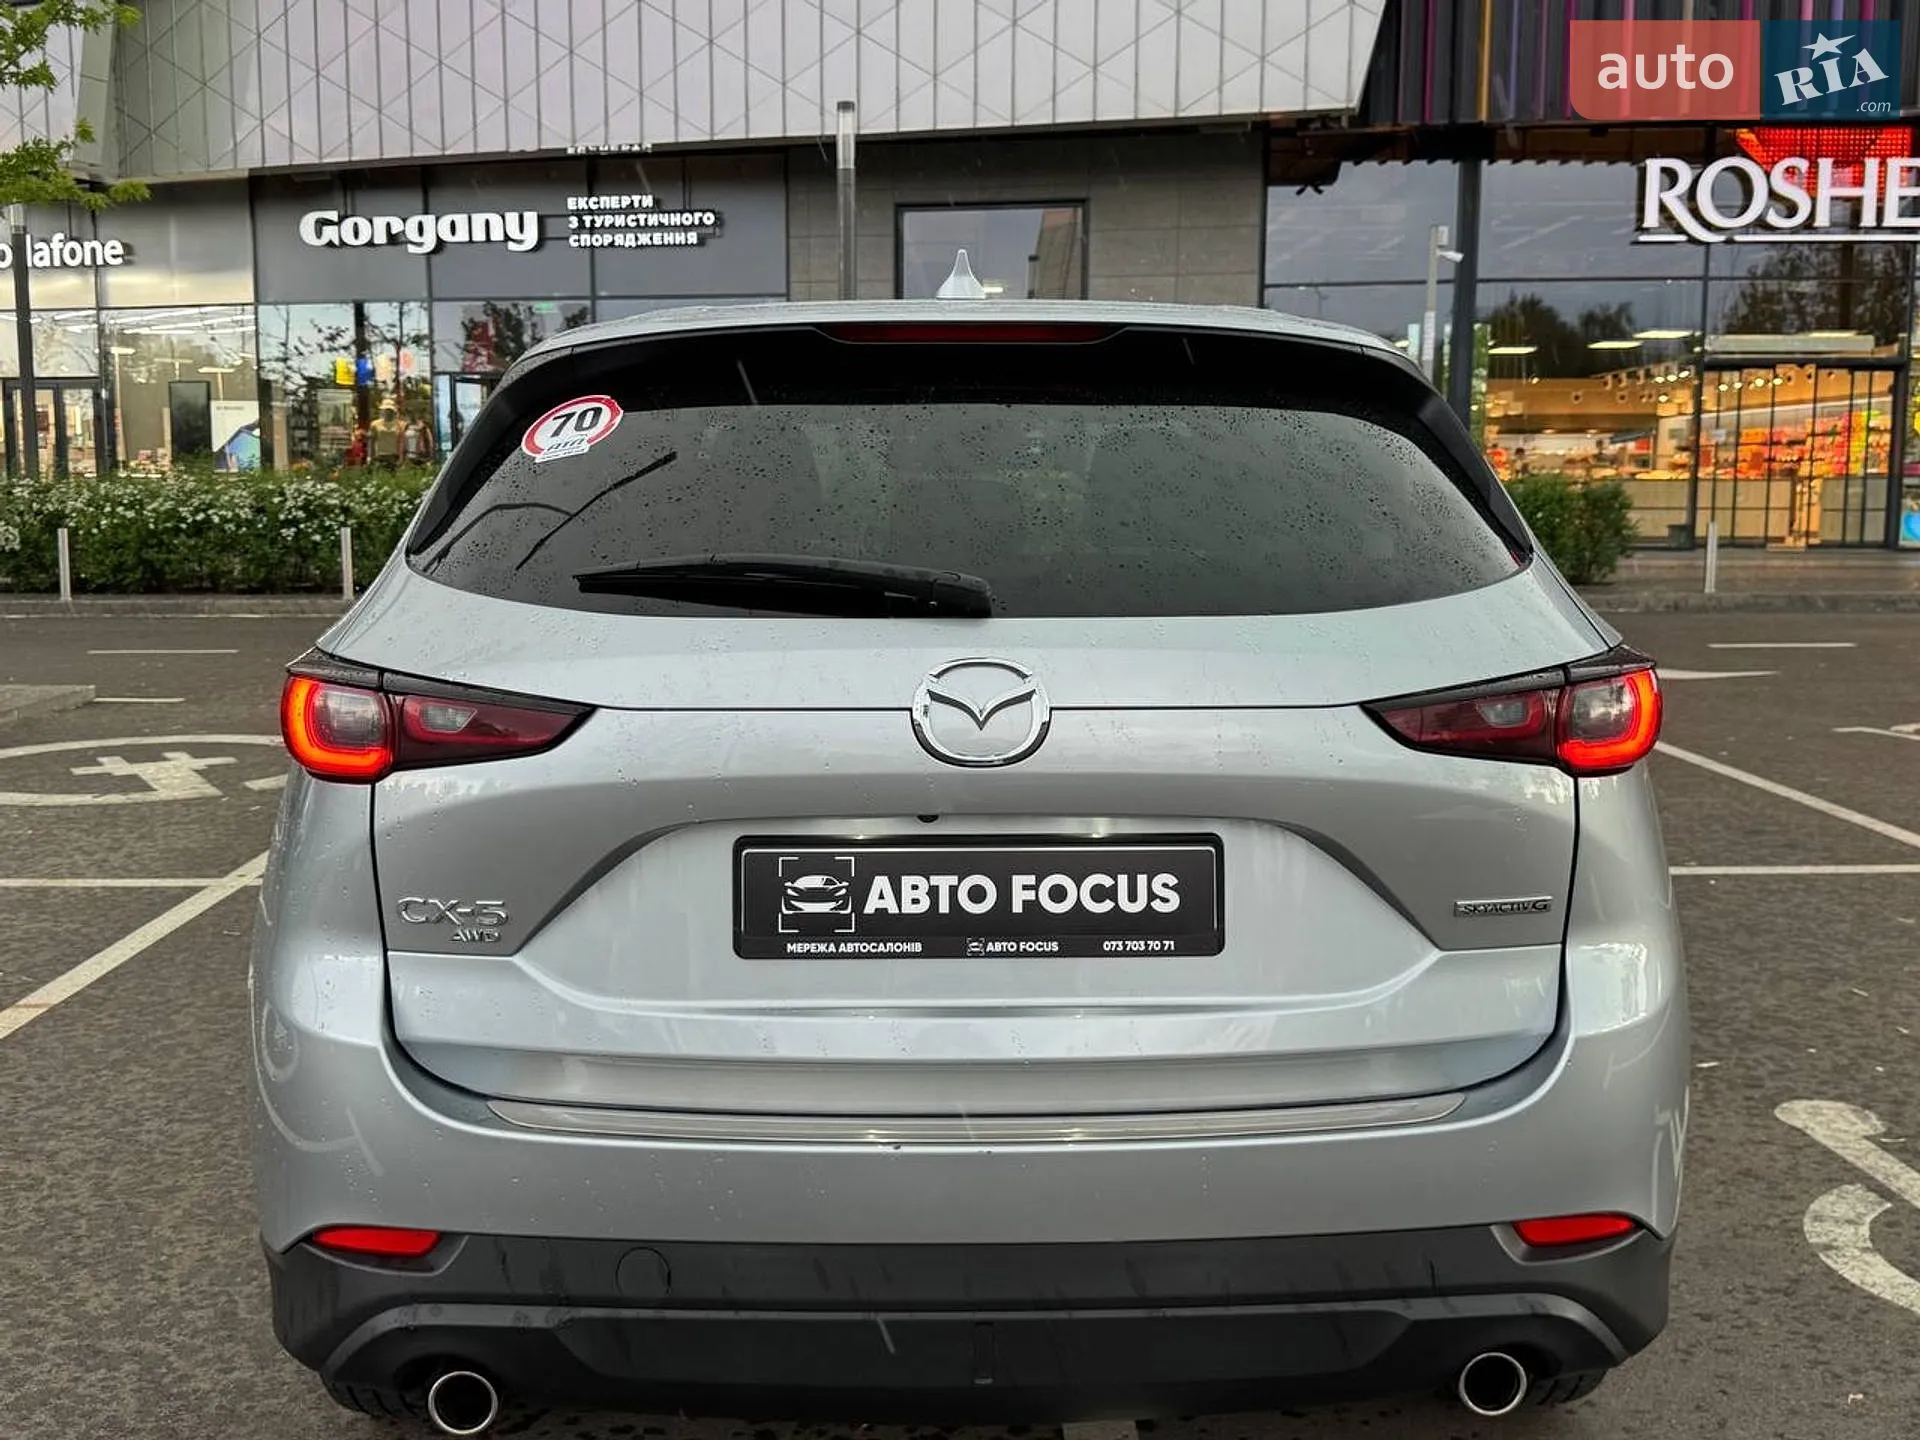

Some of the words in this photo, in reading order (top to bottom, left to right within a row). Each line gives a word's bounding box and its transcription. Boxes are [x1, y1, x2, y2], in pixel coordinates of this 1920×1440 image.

[566, 195, 654, 210] ЕКСПЕРТИ
[1641, 155, 1920, 243] ROSHE
[582, 212, 716, 228] ТУРИСТИЧНОГО
[299, 210, 540, 254] Gorgany
[568, 232, 698, 248] СПОРЯДЖЕННЯ
[551, 406, 603, 438] 70
[863, 874, 998, 914] АВТО
[1011, 873, 1181, 914] FOCUS
[398, 896, 509, 926] CX-5
[787, 943, 836, 953] МЕРЕЖА
[838, 942, 922, 953] АВТОСАЛОНІВ
[1019, 941, 1059, 952] FOCUS
[1103, 941, 1123, 951] 073
[1125, 941, 1145, 951] 703
[1147, 941, 1161, 951] 70
[1163, 941, 1174, 951] 71
